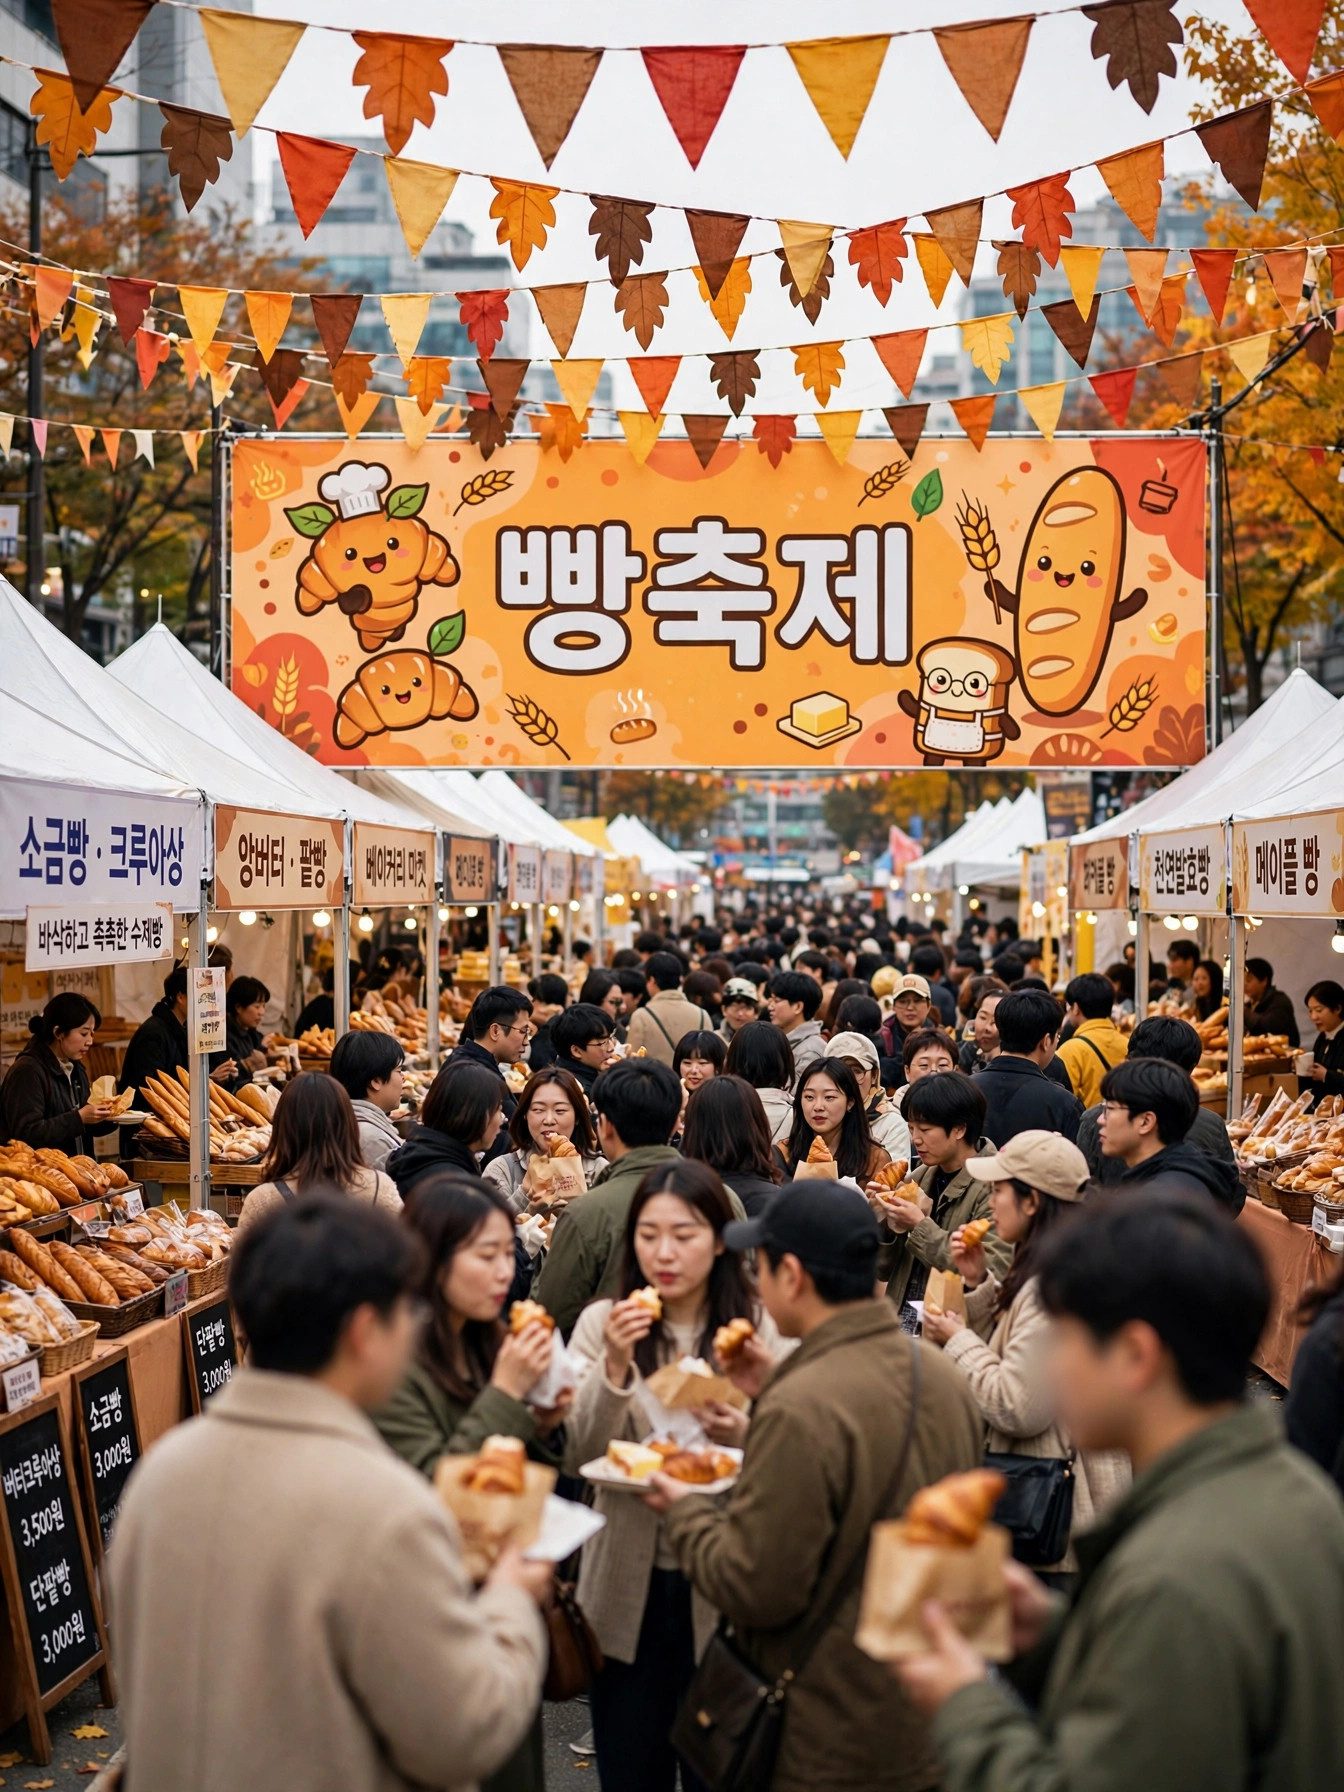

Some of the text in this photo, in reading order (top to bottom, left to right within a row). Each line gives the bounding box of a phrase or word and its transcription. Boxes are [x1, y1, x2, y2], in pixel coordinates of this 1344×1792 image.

[495, 515, 913, 676] 빵축제
[19, 815, 90, 886] 소금빵
[109, 824, 184, 887] 크루아상
[238, 832, 285, 888] 앙버터
[299, 838, 327, 889] 팥빵
[366, 844, 406, 888] 베이커리
[408, 848, 427, 889] 마켓
[1154, 844, 1211, 896] 천연발효빵
[1256, 834, 1321, 897] 메이플 빵
[38, 915, 163, 956] 바삭하고 촉촉한 수제빵
[196, 1318, 225, 1356] 단팥빵
[202, 1358, 233, 1394] 3,000원
[89, 1386, 122, 1432] 소금빵
[2, 1443, 62, 1500] 버터크루아상
[94, 1434, 133, 1479] 3,000원
[20, 1496, 65, 1548] 3,500원
[29, 1557, 72, 1613] 단팥빵
[40, 1609, 86, 1664] 3,000원
